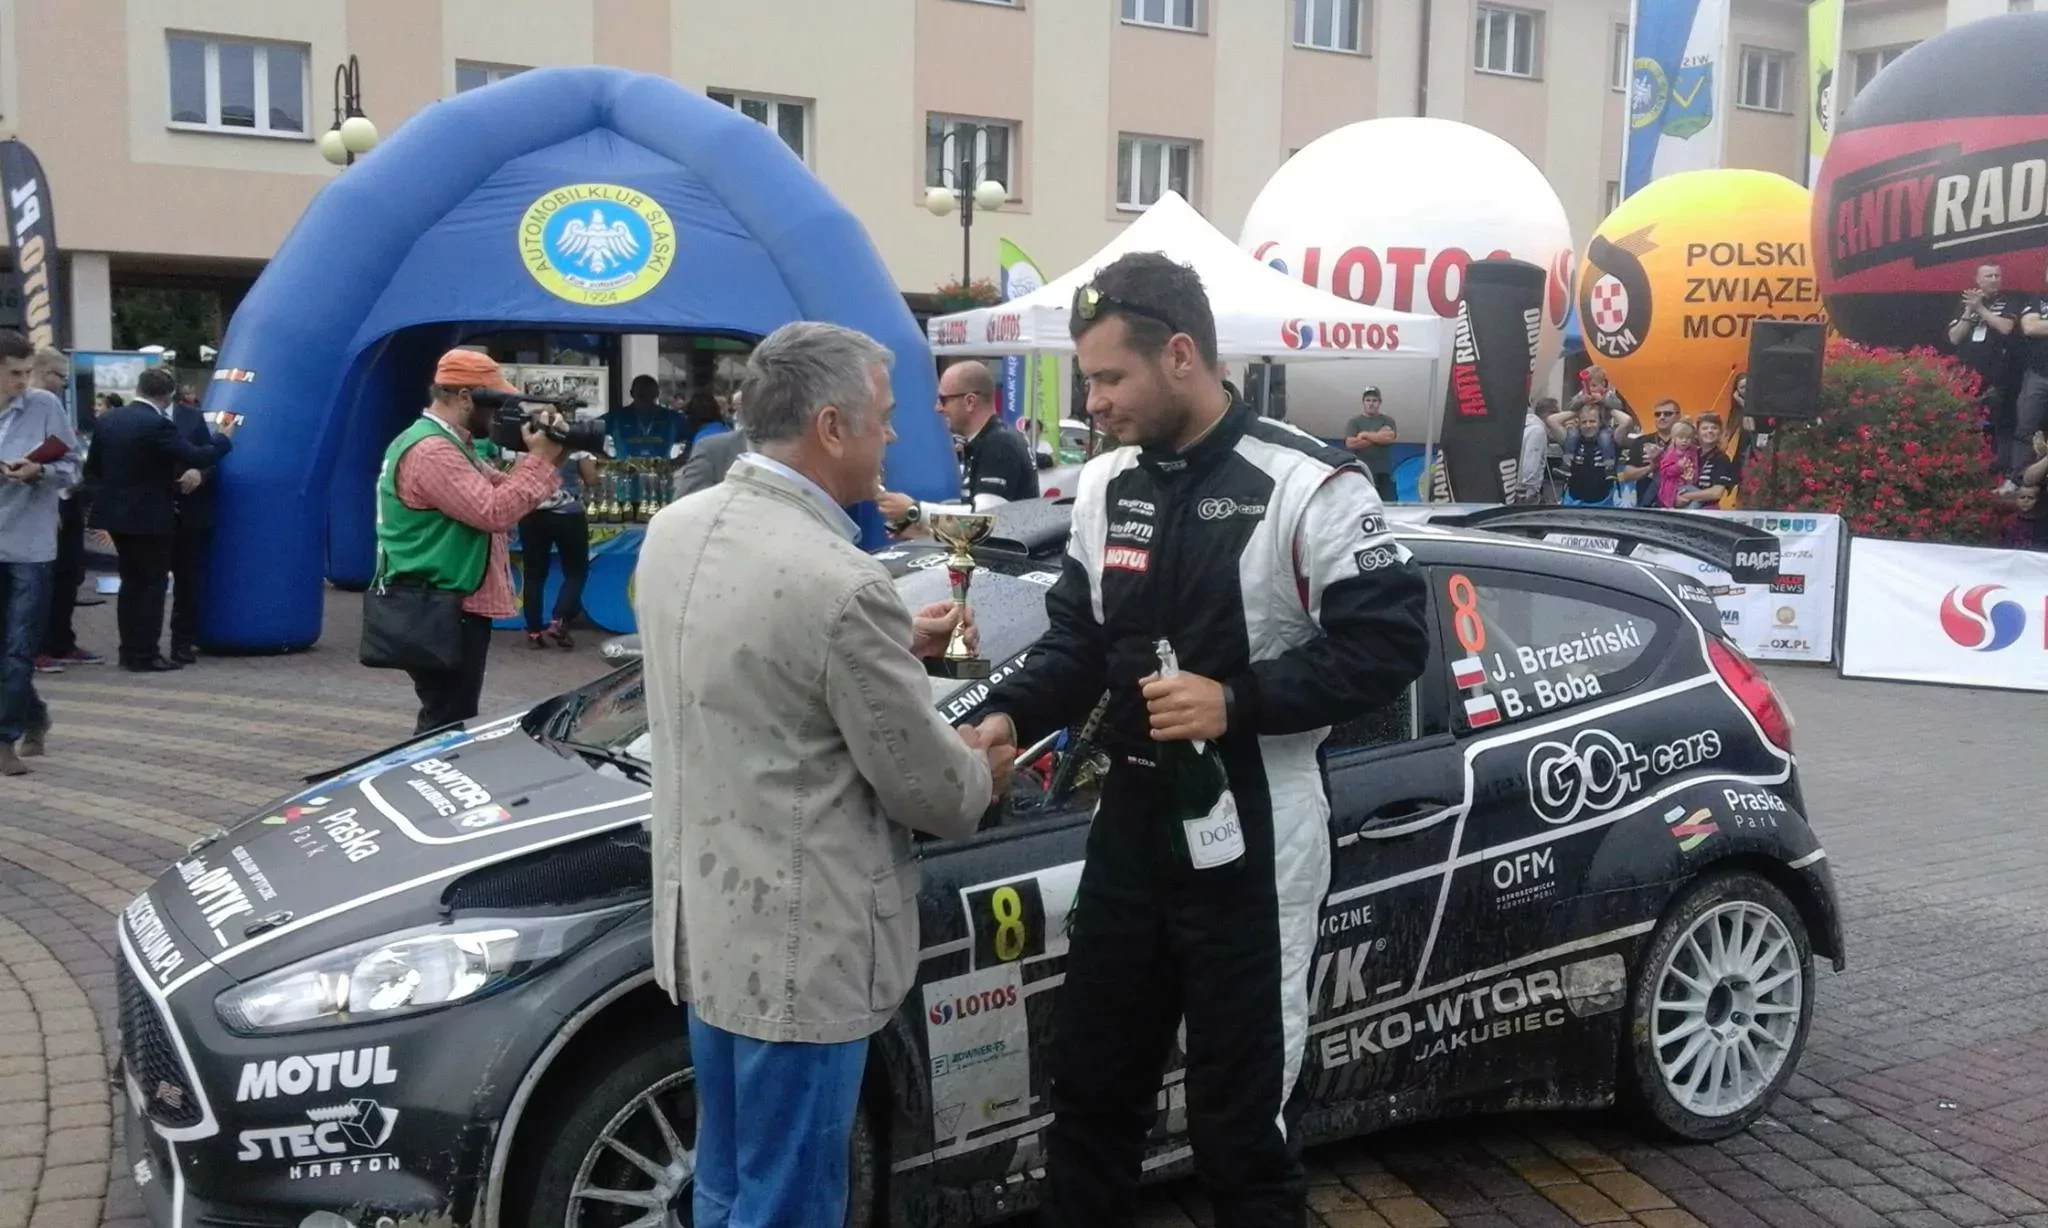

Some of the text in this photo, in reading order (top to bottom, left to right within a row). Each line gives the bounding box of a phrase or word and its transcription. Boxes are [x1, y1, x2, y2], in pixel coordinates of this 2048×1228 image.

[525, 185, 644, 273] AUTOMOBILKLUB
[1686, 241, 1806, 267] POLSKI
[582, 290, 619, 303] 1924
[1302, 246, 1513, 320] LOTO
[1684, 277, 1821, 309] ZWIĄZE
[1318, 322, 1400, 350] LOTOS
[1596, 328, 1638, 355] PZM
[1105, 549, 1148, 570] MOTUL
[1735, 551, 1780, 567] RACE
[1770, 583, 1804, 593] NEWS
[1447, 572, 1487, 653] 8
[1491, 619, 1642, 684] J. Brzeziński
[1500, 672, 1603, 718] B. Boba
[1651, 728, 1722, 776] cars
[1722, 787, 1788, 812] Praska
[317, 806, 381, 863] Praska
[1733, 813, 1779, 829] Park
[288, 824, 330, 859] Park
[1492, 846, 1555, 890] OFM
[991, 885, 1026, 962] 8
[955, 983, 1018, 1021] LOTOS
[1414, 1006, 1566, 1062] JAKUBIEC
[236, 1045, 397, 1102] MOTUL
[237, 1121, 348, 1162] STEC
